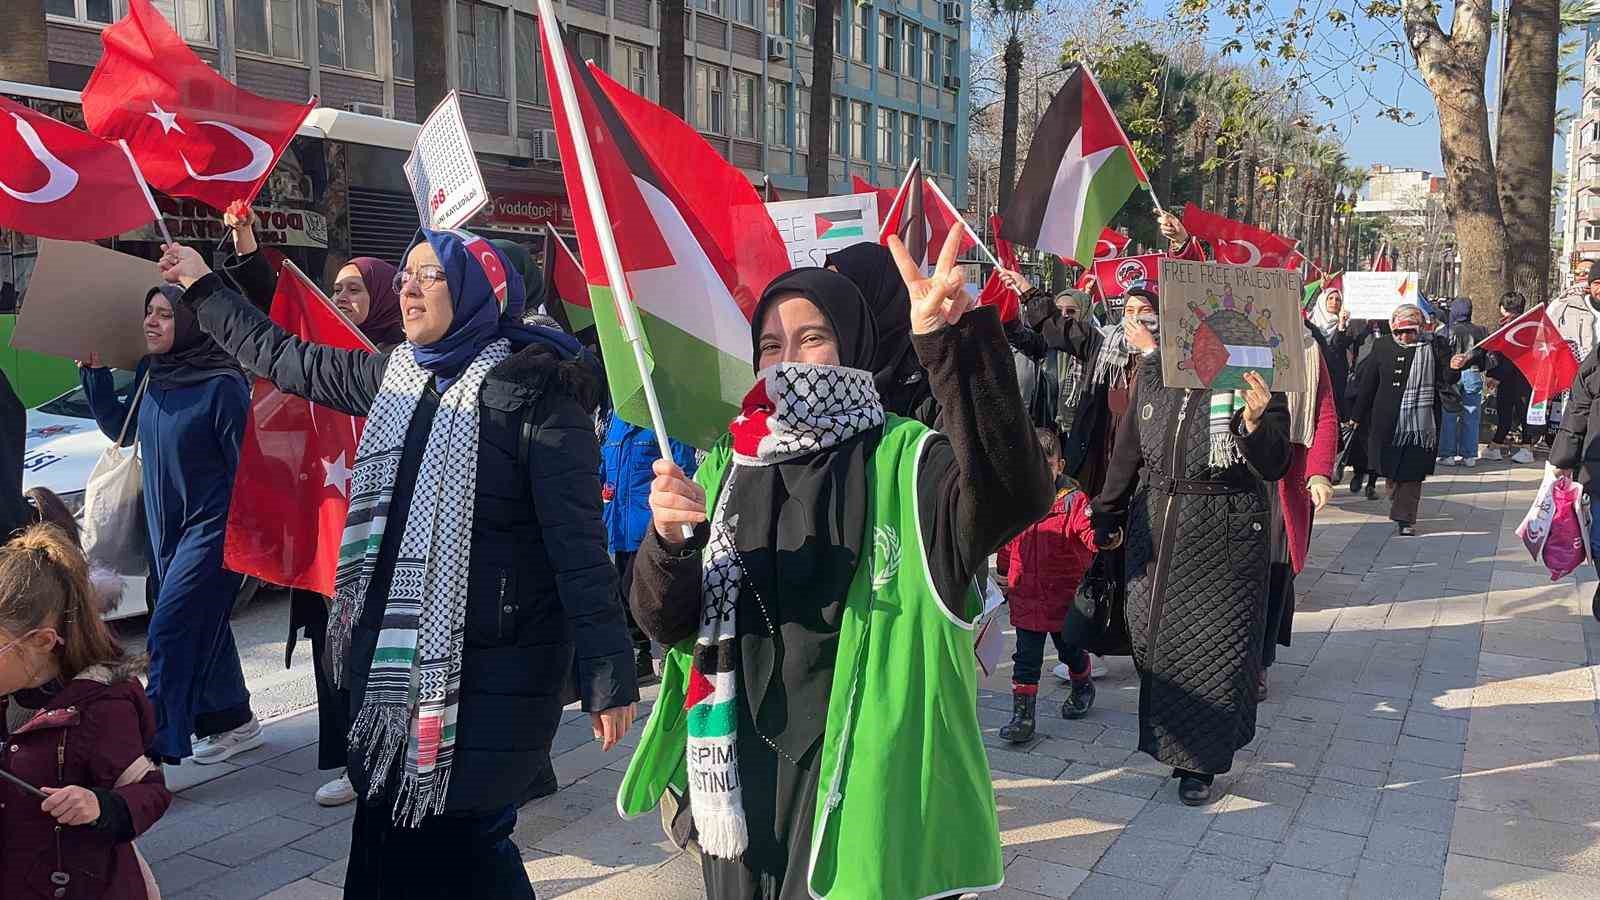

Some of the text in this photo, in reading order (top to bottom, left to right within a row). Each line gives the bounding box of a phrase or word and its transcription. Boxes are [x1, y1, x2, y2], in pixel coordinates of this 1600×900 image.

[500, 200, 553, 218] vodafone
[1164, 260, 1195, 284] FREE
[1200, 263, 1231, 286] FREE
